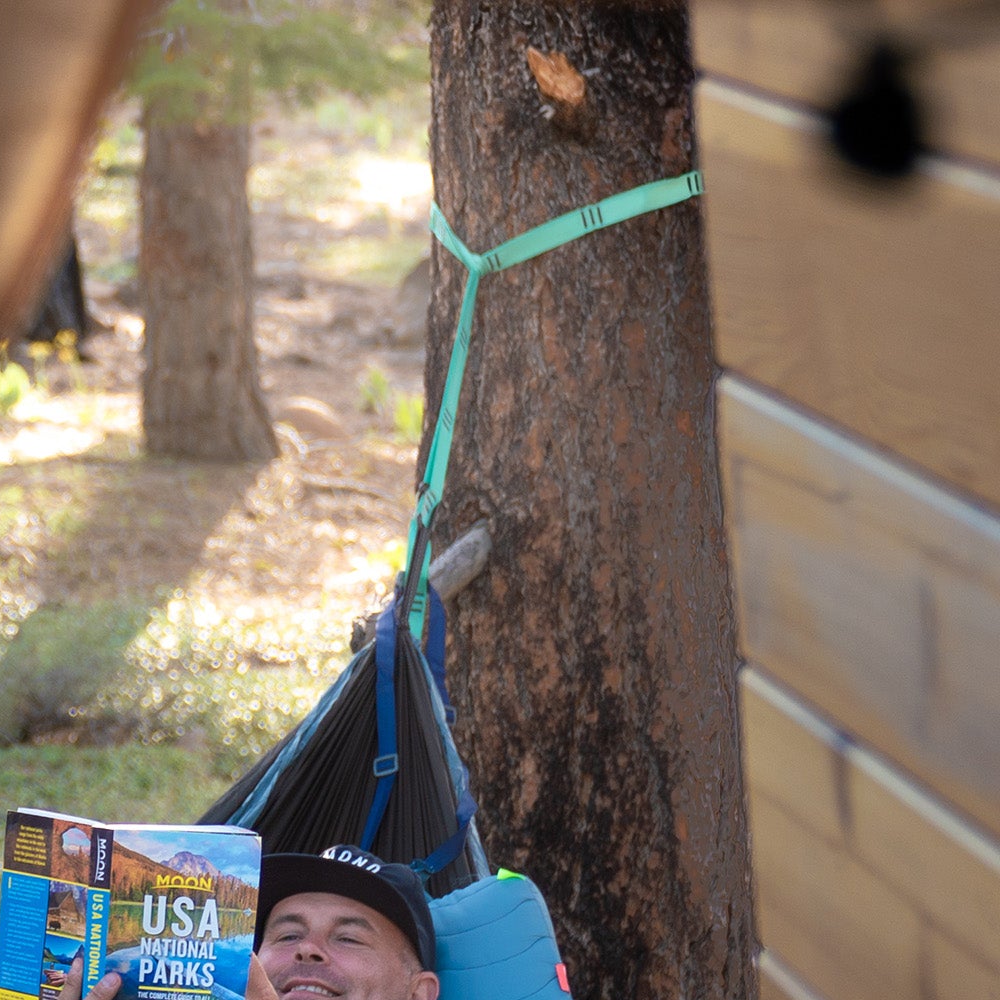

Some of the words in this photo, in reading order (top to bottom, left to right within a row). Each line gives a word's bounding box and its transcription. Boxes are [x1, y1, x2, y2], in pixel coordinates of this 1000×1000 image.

[96, 838, 107, 881] MOON
[156, 875, 213, 891] MOON
[91, 893, 104, 920] USA
[142, 894, 220, 938] USA
[87, 923, 102, 981] NATIONAL
[140, 937, 217, 960] NATIONAL
[139, 958, 215, 987] PARKS
[138, 991, 148, 999] THE
[149, 992, 177, 1000] COMPLETE
